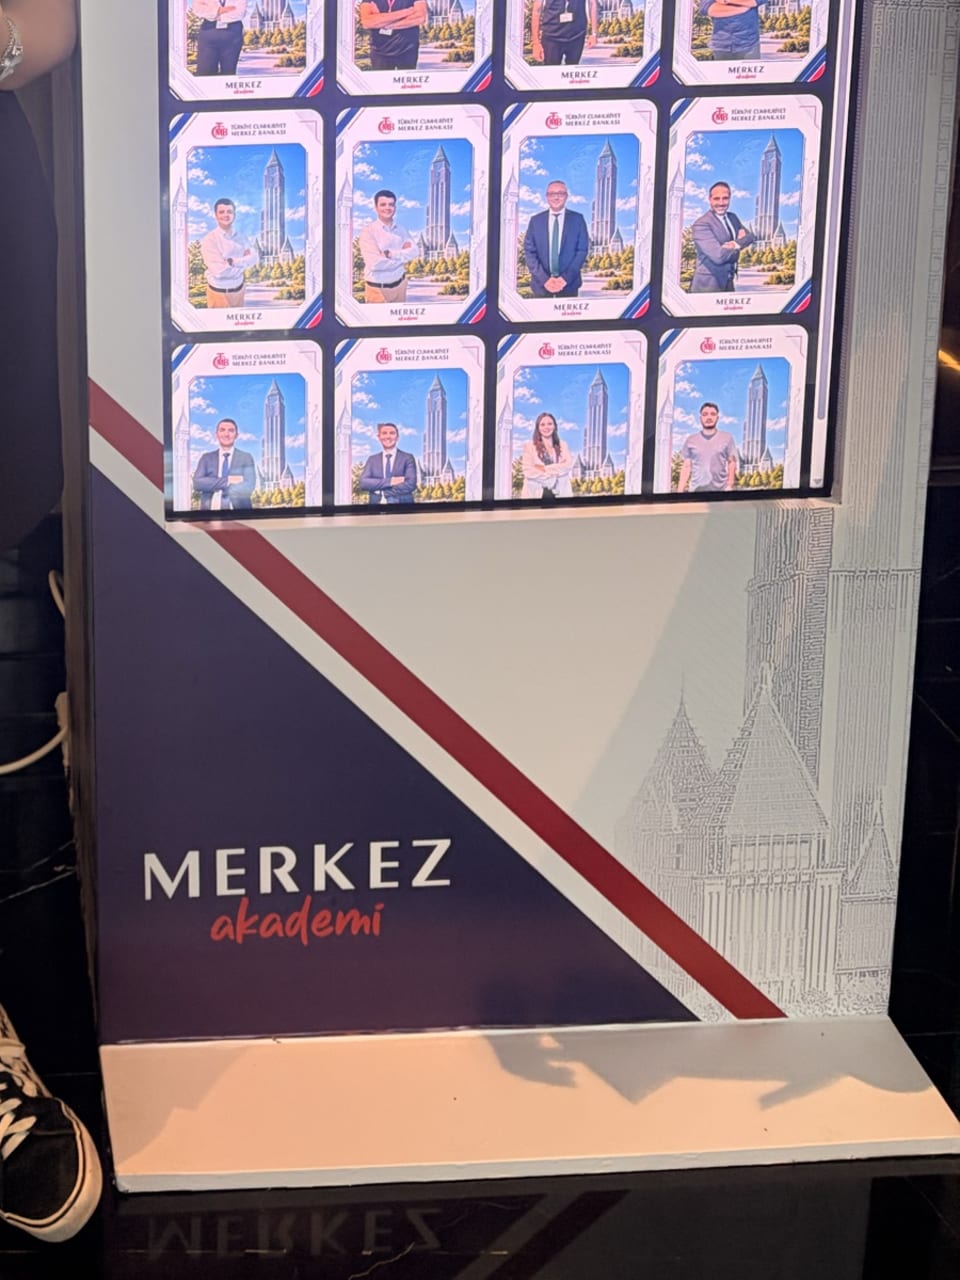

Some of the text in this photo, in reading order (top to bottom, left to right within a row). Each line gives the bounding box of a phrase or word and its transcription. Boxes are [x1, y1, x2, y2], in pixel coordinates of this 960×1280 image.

[727, 65, 765, 74] MERKEZ
[560, 70, 598, 79] MERKEZ
[392, 75, 430, 84] MERKEZ
[225, 80, 262, 89] MERKEZ
[715, 297, 751, 306] MERKEZ
[389, 307, 426, 316] MERKEZ
[553, 303, 590, 311] MERKEZ
[226, 312, 262, 321] MERKEZ
[144, 838, 452, 901] MERKEZ
[210, 895, 385, 946] akademi
